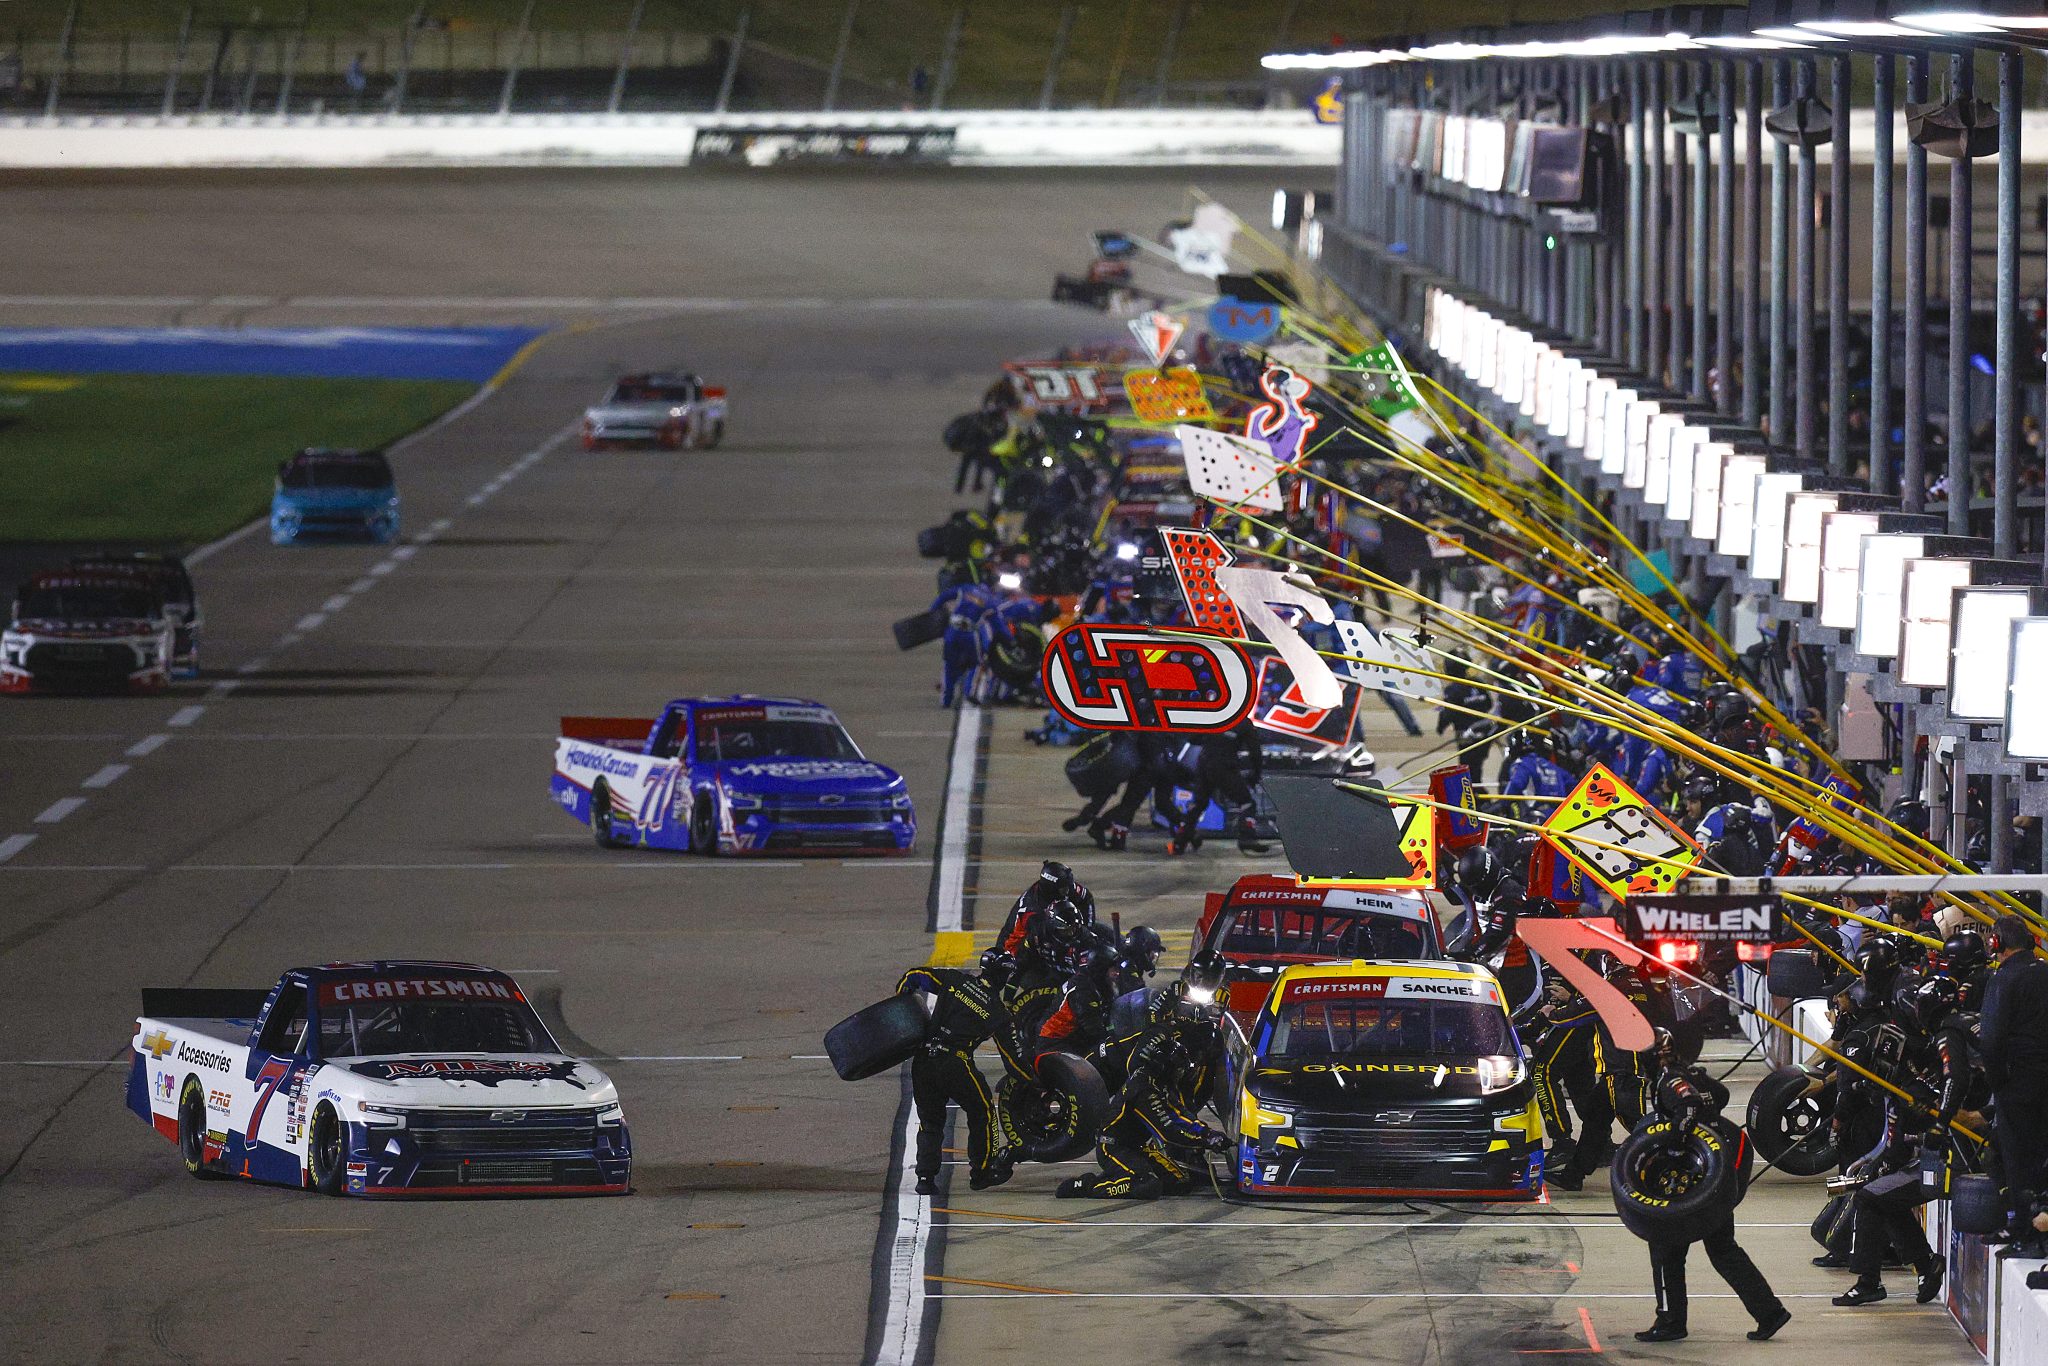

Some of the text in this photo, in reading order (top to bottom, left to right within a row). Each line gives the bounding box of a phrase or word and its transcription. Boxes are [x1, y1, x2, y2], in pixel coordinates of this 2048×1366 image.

[1241, 891, 1393, 910] CRAFTSMAN HEIM
[1635, 904, 1772, 932] WHELEN
[334, 980, 511, 1000] CRAFTSMAN
[1294, 983, 1382, 995] CRAFTSMAN
[954, 990, 991, 1020] GAINBRIDGE
[177, 1041, 232, 1074] Accessories
[317, 1089, 342, 1103] GOODYEAR
[1533, 1062, 1551, 1112] GAINBRIDGE
[209, 1090, 232, 1108] PRG
[244, 1054, 294, 1151] 7
[1068, 1095, 1078, 1137] EAGLE
[377, 1166, 394, 1185] 7
[1262, 1165, 1281, 1182] 2
[1629, 1190, 1670, 1207] EAGLE
